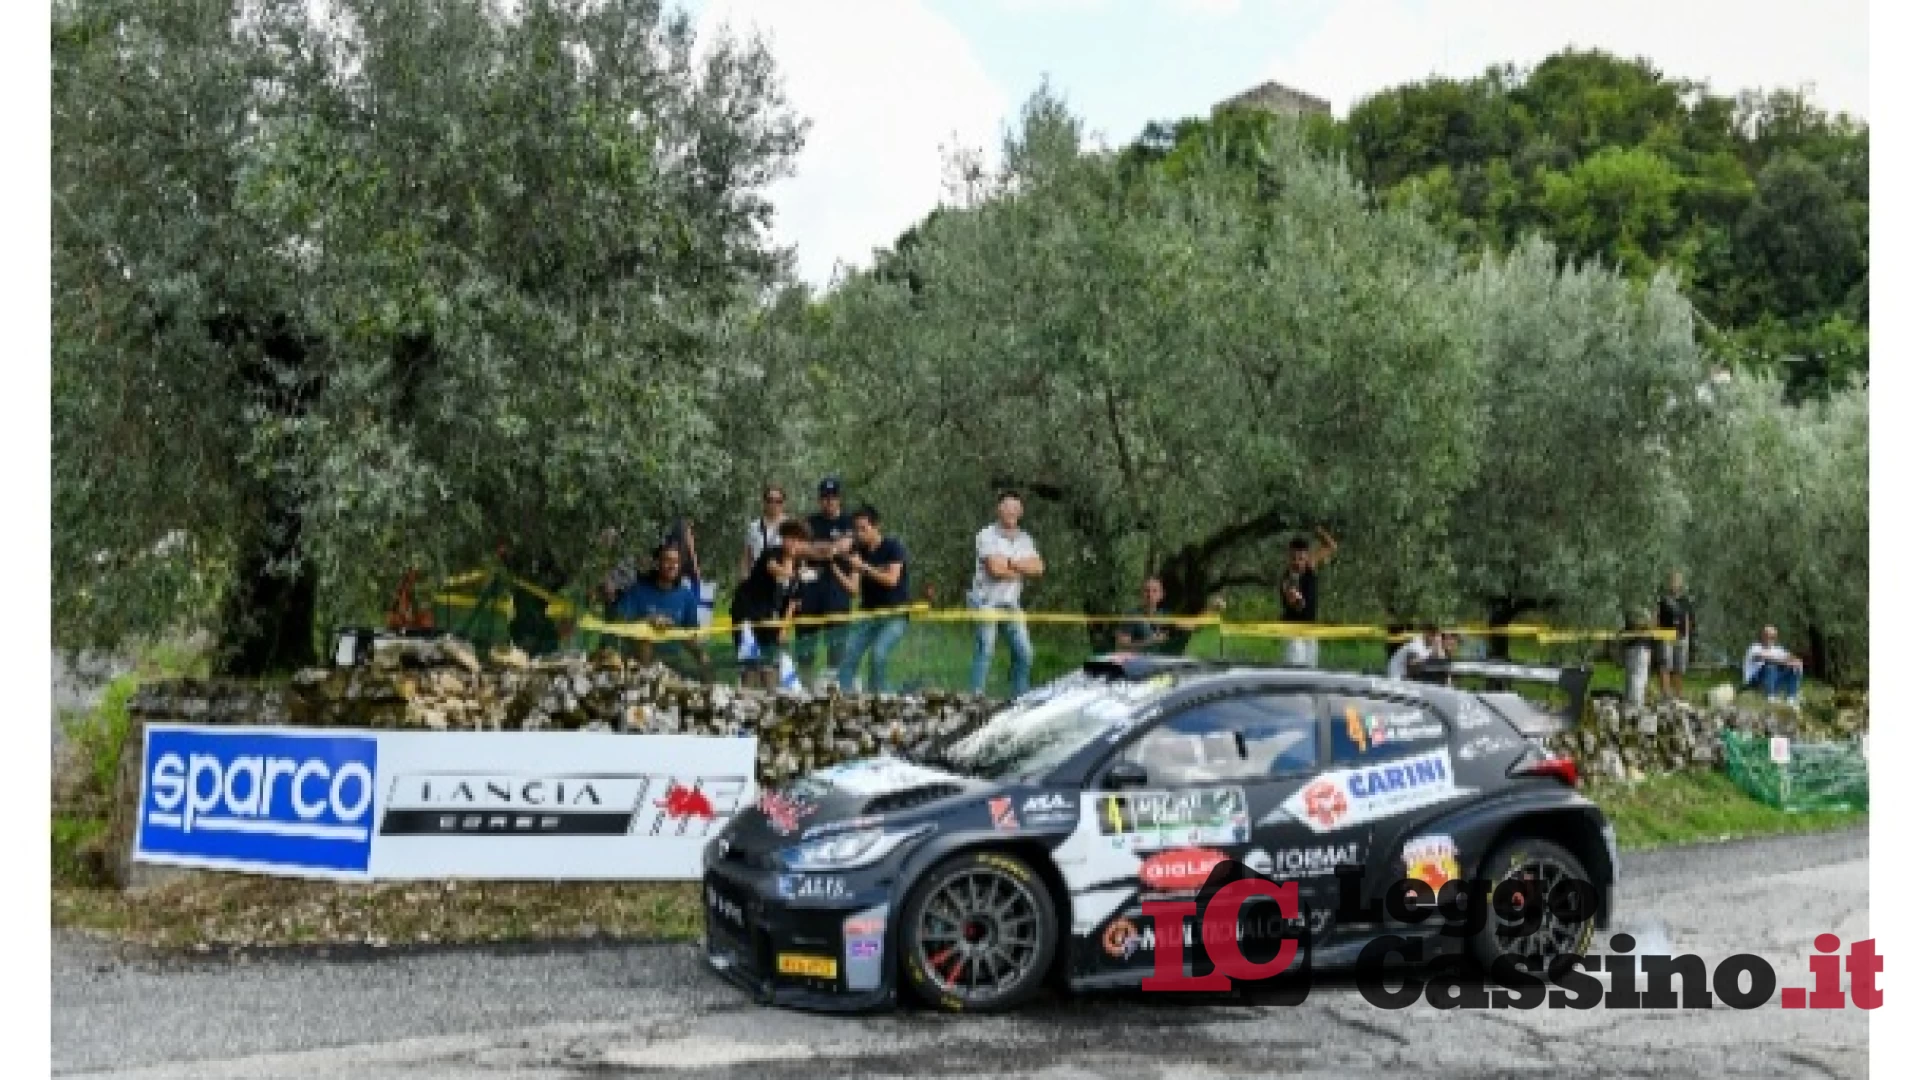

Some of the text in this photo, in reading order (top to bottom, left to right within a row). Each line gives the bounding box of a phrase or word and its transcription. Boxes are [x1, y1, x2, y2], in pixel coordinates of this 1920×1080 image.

[1345, 704, 1368, 753] 4
[151, 752, 373, 833] sparco
[421, 780, 602, 806] LANCIA
[1348, 758, 1446, 799] CARINI
[1276, 843, 1358, 872] FORMAT
